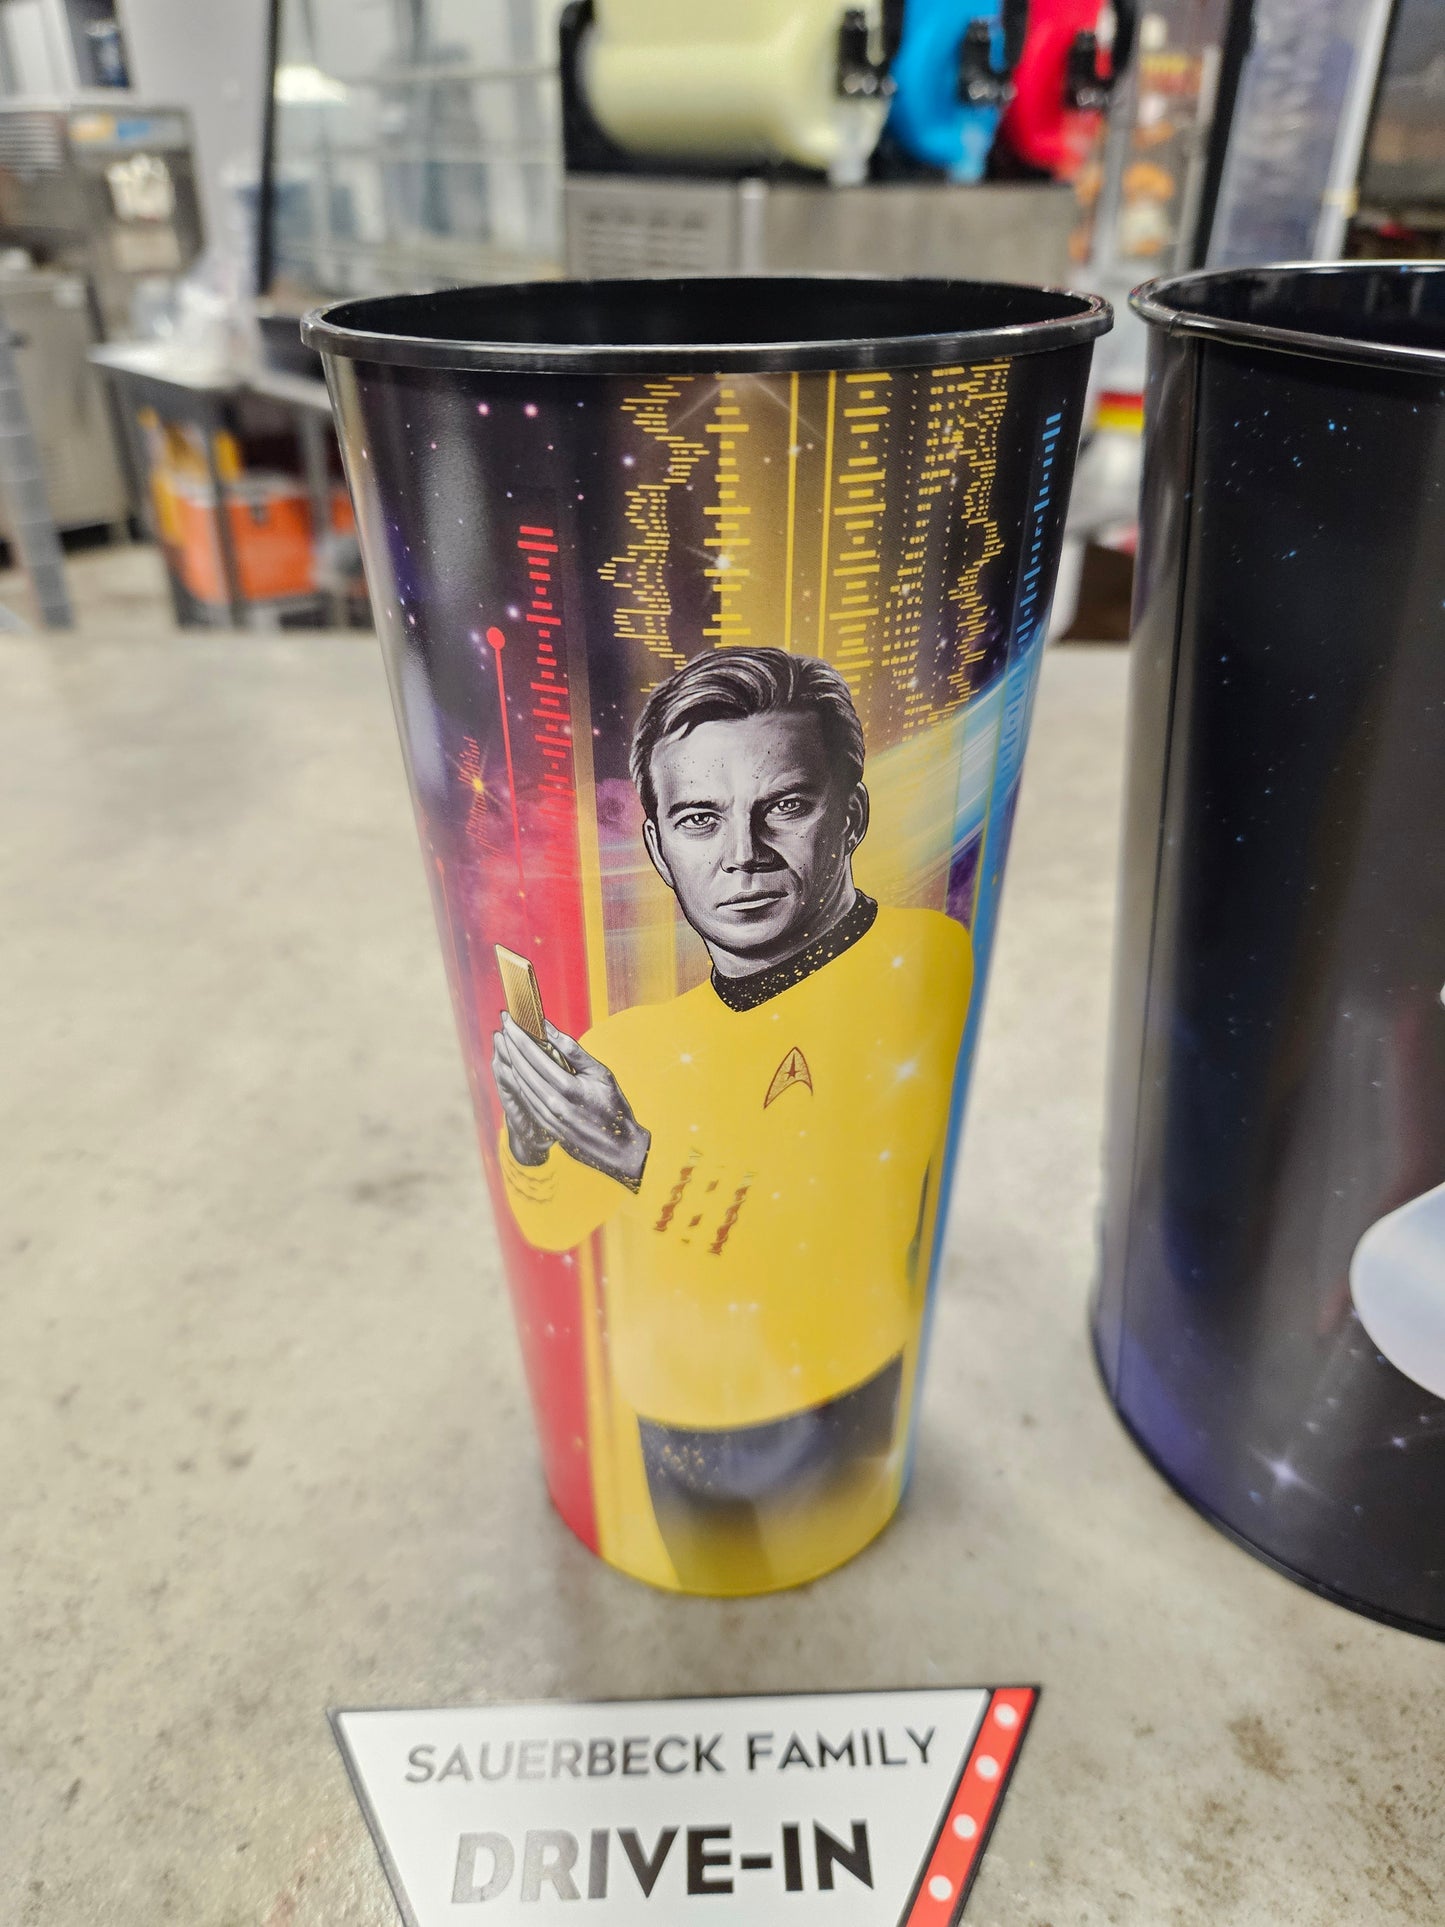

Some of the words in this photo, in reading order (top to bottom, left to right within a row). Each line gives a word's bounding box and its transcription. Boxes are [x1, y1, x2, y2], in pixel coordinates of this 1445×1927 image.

[404, 1733, 724, 1784] SAUERBECK
[746, 1726, 938, 1771] FAMILY
[451, 1819, 875, 1904] DRIVE-IN
